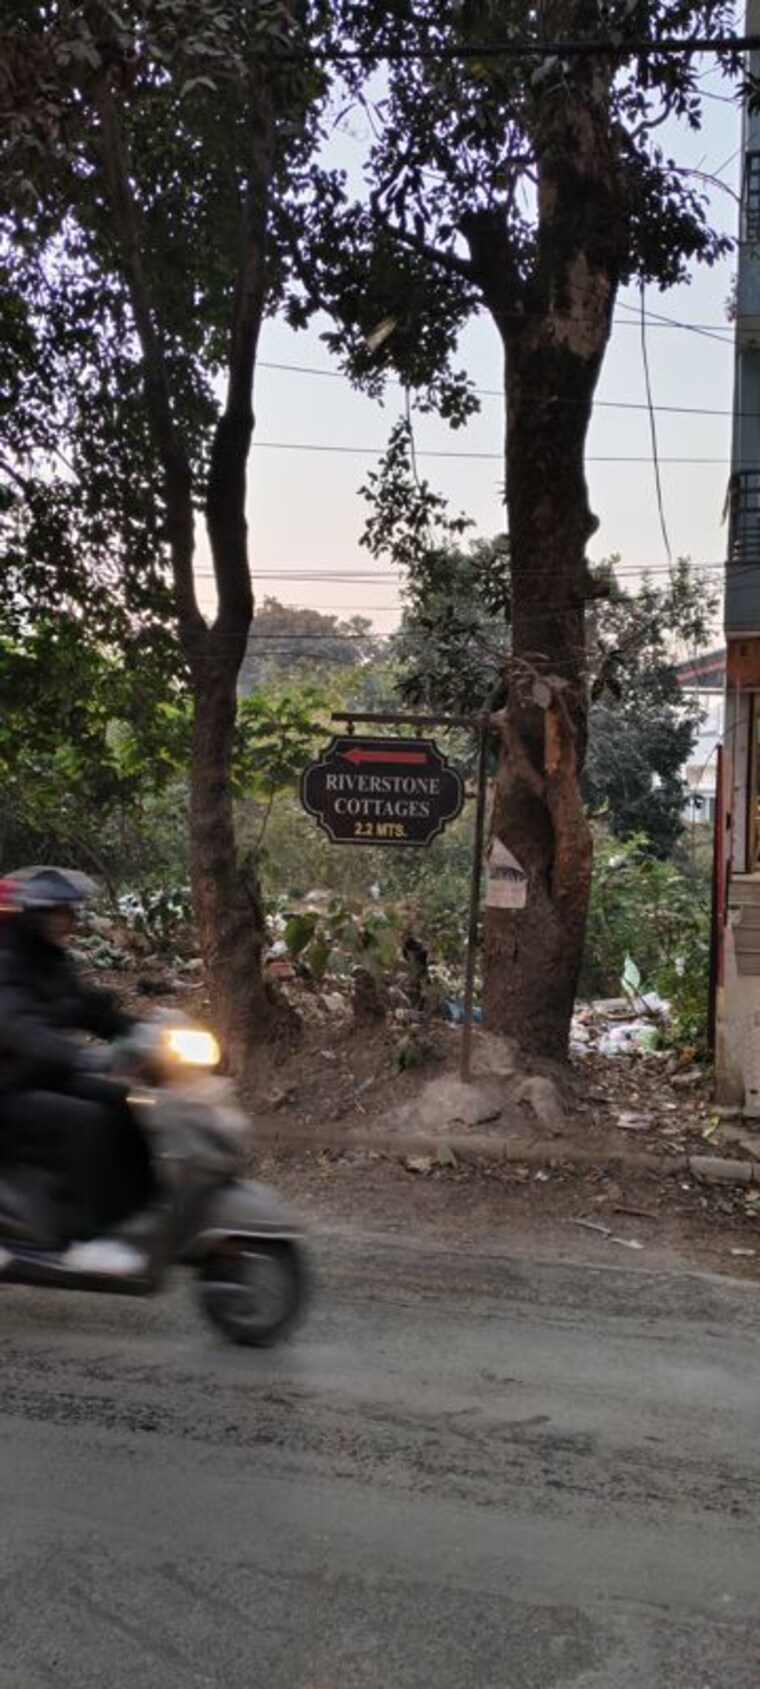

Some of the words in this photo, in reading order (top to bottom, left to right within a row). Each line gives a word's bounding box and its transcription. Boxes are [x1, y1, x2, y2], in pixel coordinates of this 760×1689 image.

[326, 774, 440, 795] RIVERSTONE
[334, 797, 430, 817] COTTAGES
[355, 821, 373, 836] 2.2
[377, 822, 407, 837] MTS.
